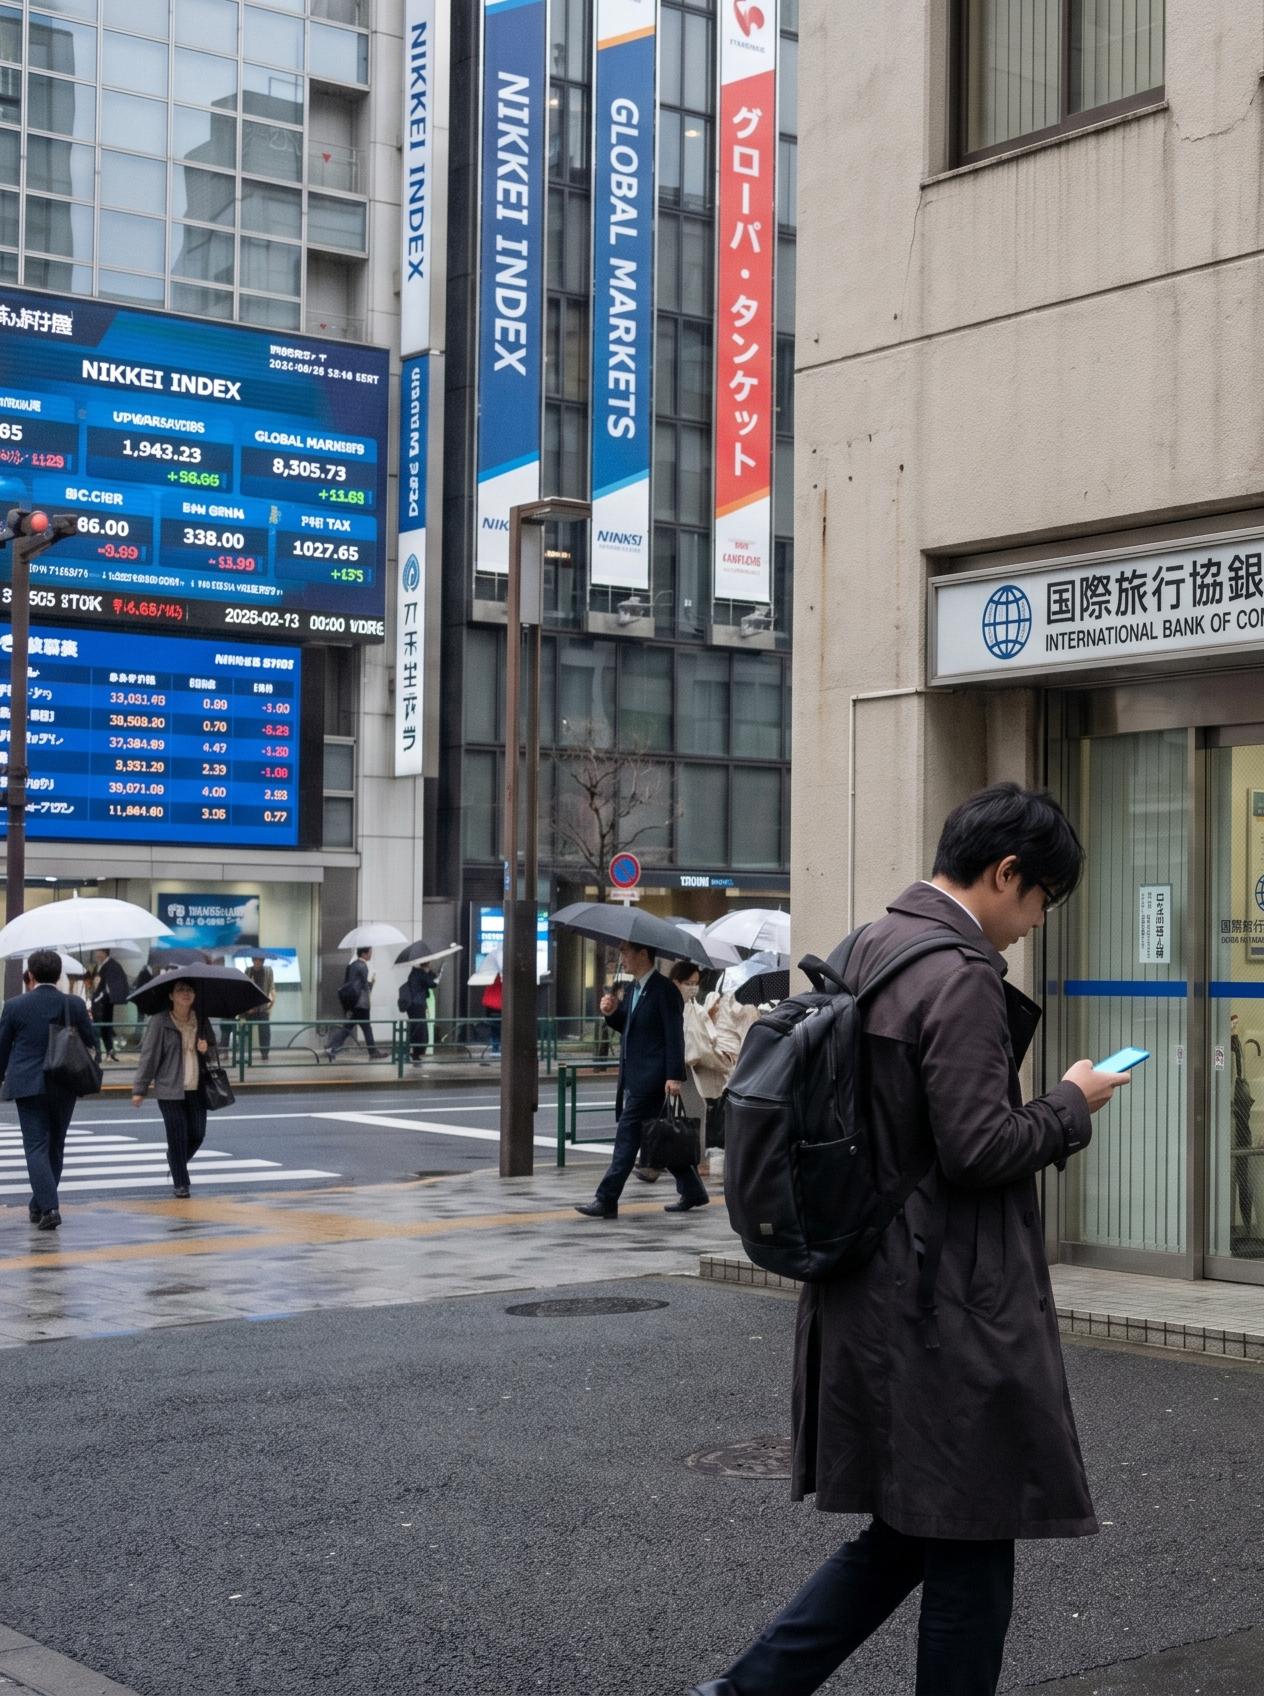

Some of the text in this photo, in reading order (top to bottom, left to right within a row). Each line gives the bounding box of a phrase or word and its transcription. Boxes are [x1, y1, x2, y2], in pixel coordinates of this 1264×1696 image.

[408, 21, 427, 283] NIKKEI INDEX
[494, 71, 530, 376] NIKKEI INDEX
[607, 98, 640, 440] GLOBAL MARKETS
[82, 359, 242, 400] NIKKEI INDEX
[122, 439, 202, 464] 1,943.23
[254, 430, 304, 448] GLOBAL
[272, 458, 347, 482] 8,305.73
[326, 518, 351, 532] TAX
[183, 528, 245, 549] 338.00
[292, 540, 359, 561] 1027.65
[1045, 622, 1158, 652] INTERNATIONAL
[1162, 614, 1206, 639] BANK
[1210, 611, 1231, 633] OF
